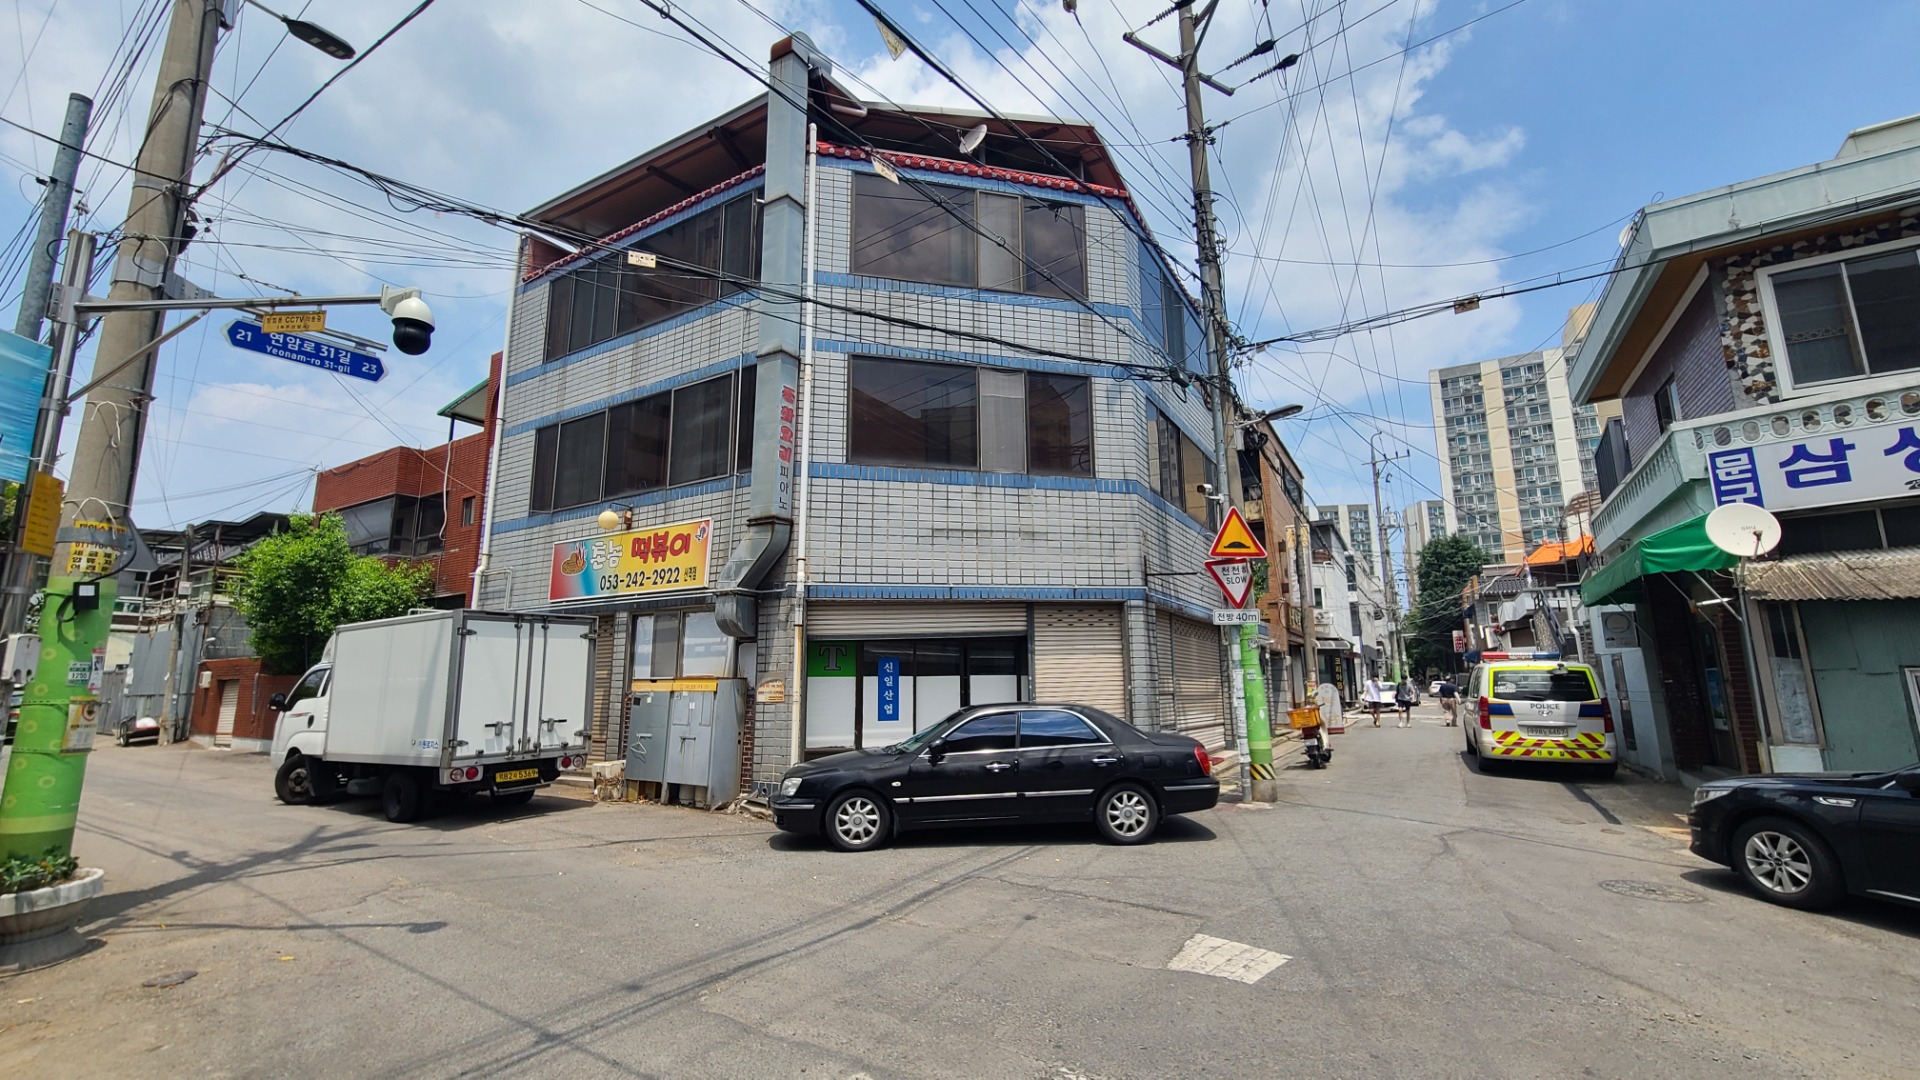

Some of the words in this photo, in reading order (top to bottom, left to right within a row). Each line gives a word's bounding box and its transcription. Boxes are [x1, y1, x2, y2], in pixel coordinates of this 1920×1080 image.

[285, 316, 304, 324] CCTV
[236, 329, 252, 342] 21
[266, 345, 321, 367] Yeonam-ro
[324, 359, 350, 374] 31-gil
[361, 362, 377, 374] 23
[779, 466, 789, 510] 피아노
[1715, 453, 1757, 504] 문구
[631, 531, 691, 564] 떡볶이
[600, 567, 680, 591] 053-242-2922
[1221, 564, 1249, 576] 천천히
[1226, 575, 1247, 585] SLOW
[1217, 613, 1234, 621] 전방
[1236, 612, 1257, 621] 40m
[819, 645, 847, 670] T
[884, 662, 894, 714] 신일산업
